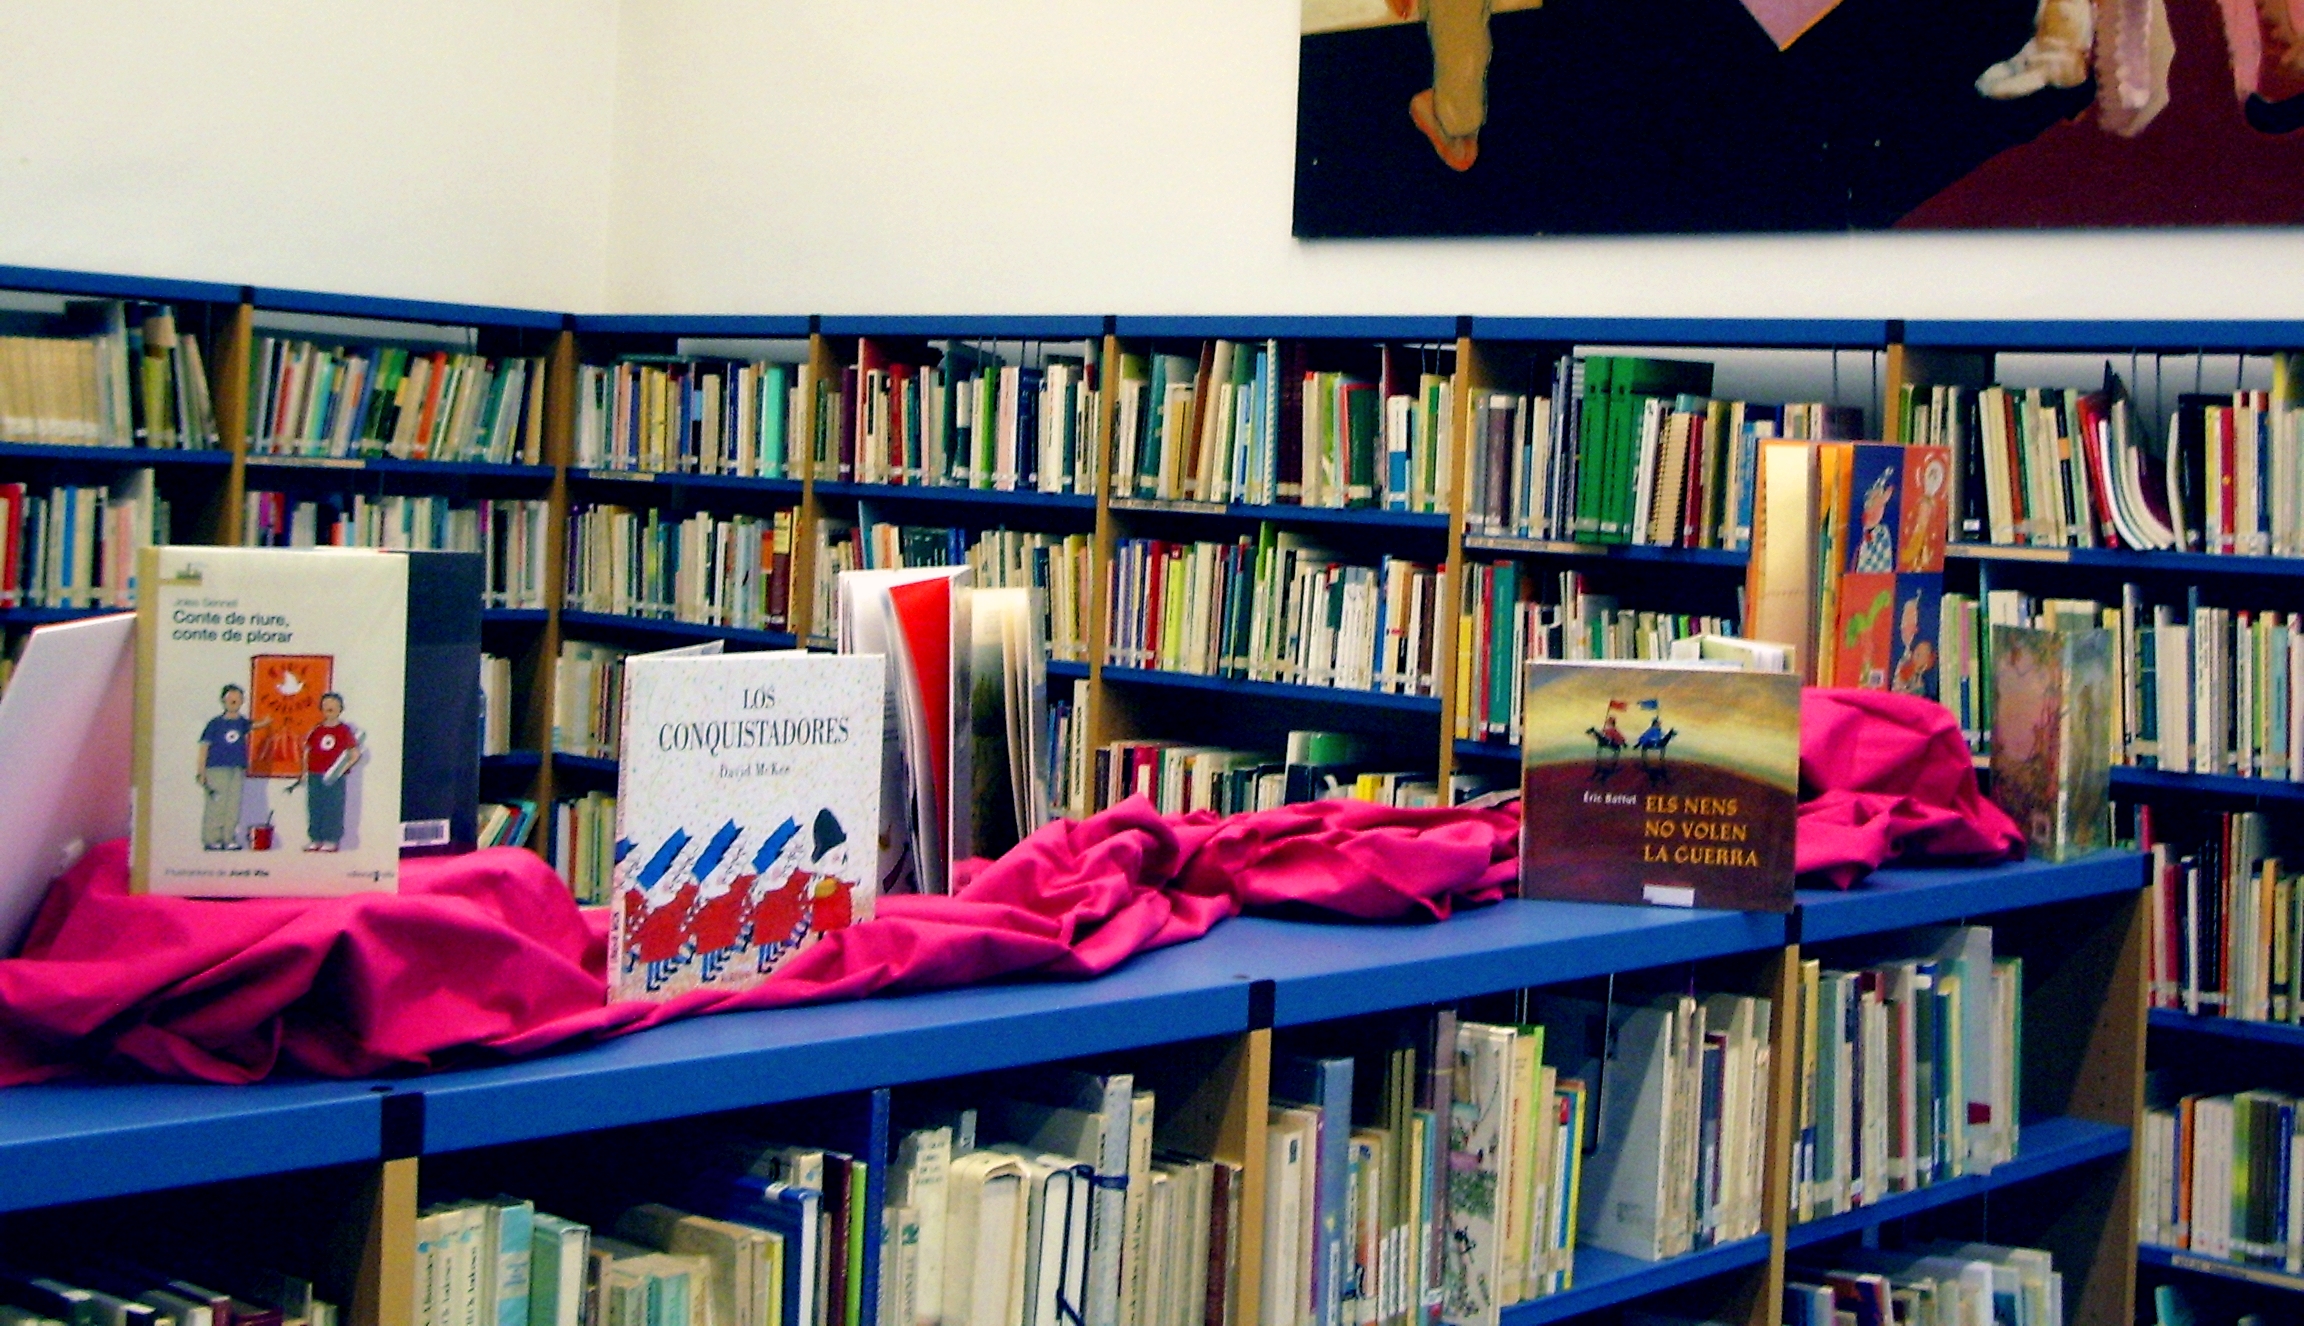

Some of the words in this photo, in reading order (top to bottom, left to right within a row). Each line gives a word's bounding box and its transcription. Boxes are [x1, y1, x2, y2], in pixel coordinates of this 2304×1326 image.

[173, 609, 221, 624] Conte
[225, 611, 246, 625] de
[249, 613, 290, 628] riure,
[172, 629, 218, 641] conte
[222, 629, 242, 642] de
[246, 630, 293, 644] plorar
[743, 687, 776, 710] LOS
[658, 716, 850, 757] CONQUISTADORES
[1645, 794, 1679, 814] ELS
[1684, 797, 1738, 816] NENS
[1645, 819, 1675, 838] NO
[1682, 820, 1747, 841] VOLEN
[1644, 845, 1669, 863] LA
[1675, 845, 1760, 867] GUERRA
